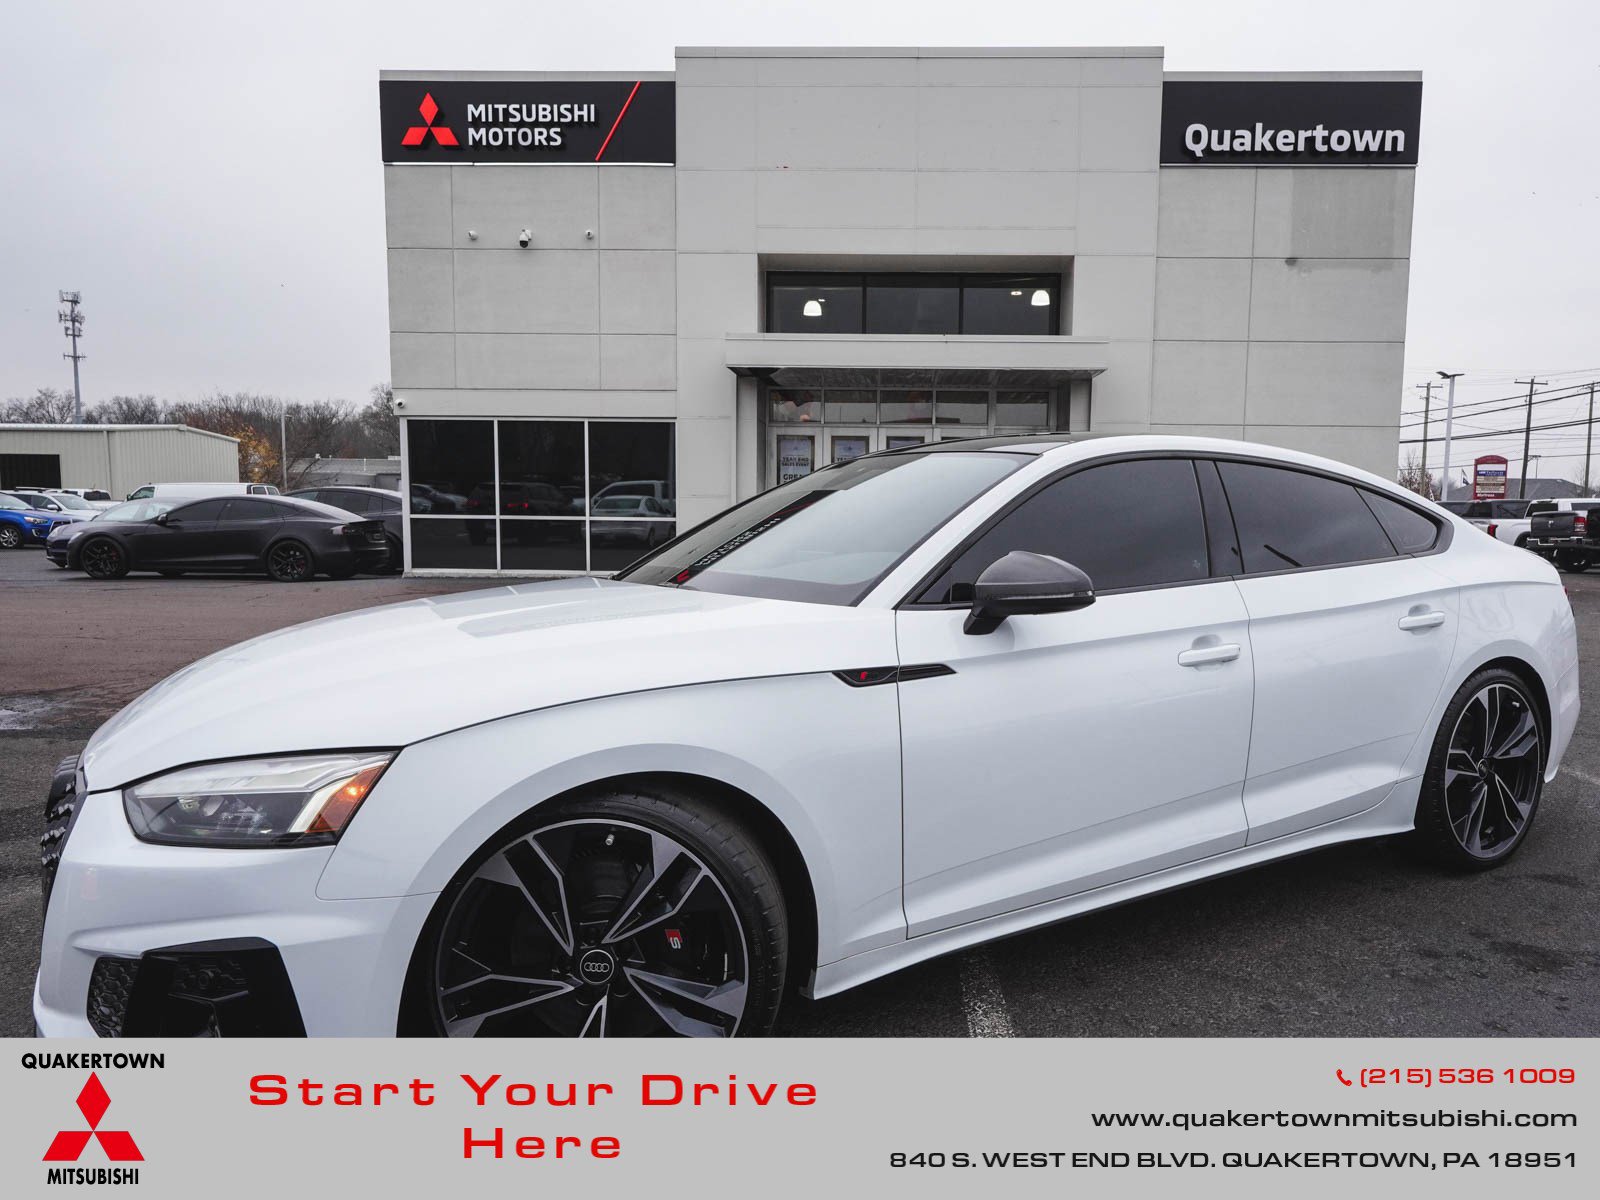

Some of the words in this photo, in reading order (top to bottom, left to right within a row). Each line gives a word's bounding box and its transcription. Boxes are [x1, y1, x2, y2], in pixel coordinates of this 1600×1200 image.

[467, 103, 596, 123] MITSUBISHI
[468, 127, 562, 146] MOTORS
[1185, 122, 1406, 157] Quakertown
